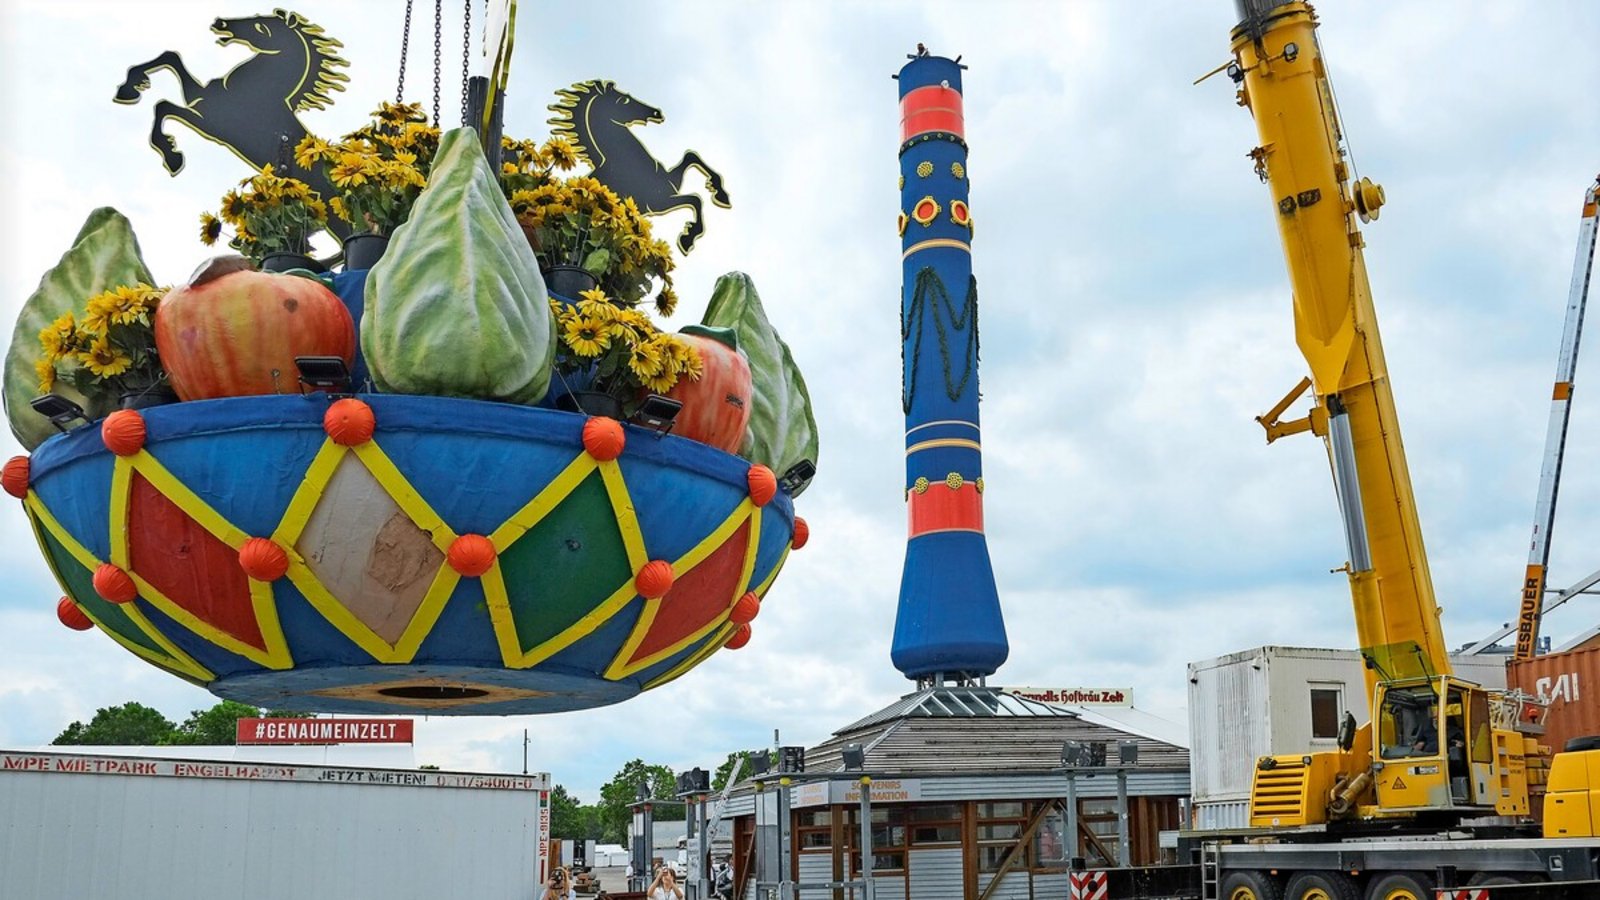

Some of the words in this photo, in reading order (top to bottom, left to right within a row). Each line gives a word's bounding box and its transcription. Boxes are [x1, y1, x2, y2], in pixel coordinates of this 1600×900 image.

[1516, 578, 1538, 660] IESBAUER
[1101, 691, 1124, 703] Zelt
[1536, 672, 1579, 705] CAI
[255, 722, 396, 739] #GENAUMEINZELT
[4, 756, 50, 770] MPE
[56, 758, 157, 774] MIETPARK
[318, 770, 364, 781] JETZT
[369, 772, 427, 785] MIETEN!
[437, 775, 532, 789] 011/54001-0
[851, 780, 901, 790] SOVENIRS
[845, 791, 908, 801] INFRMATION
